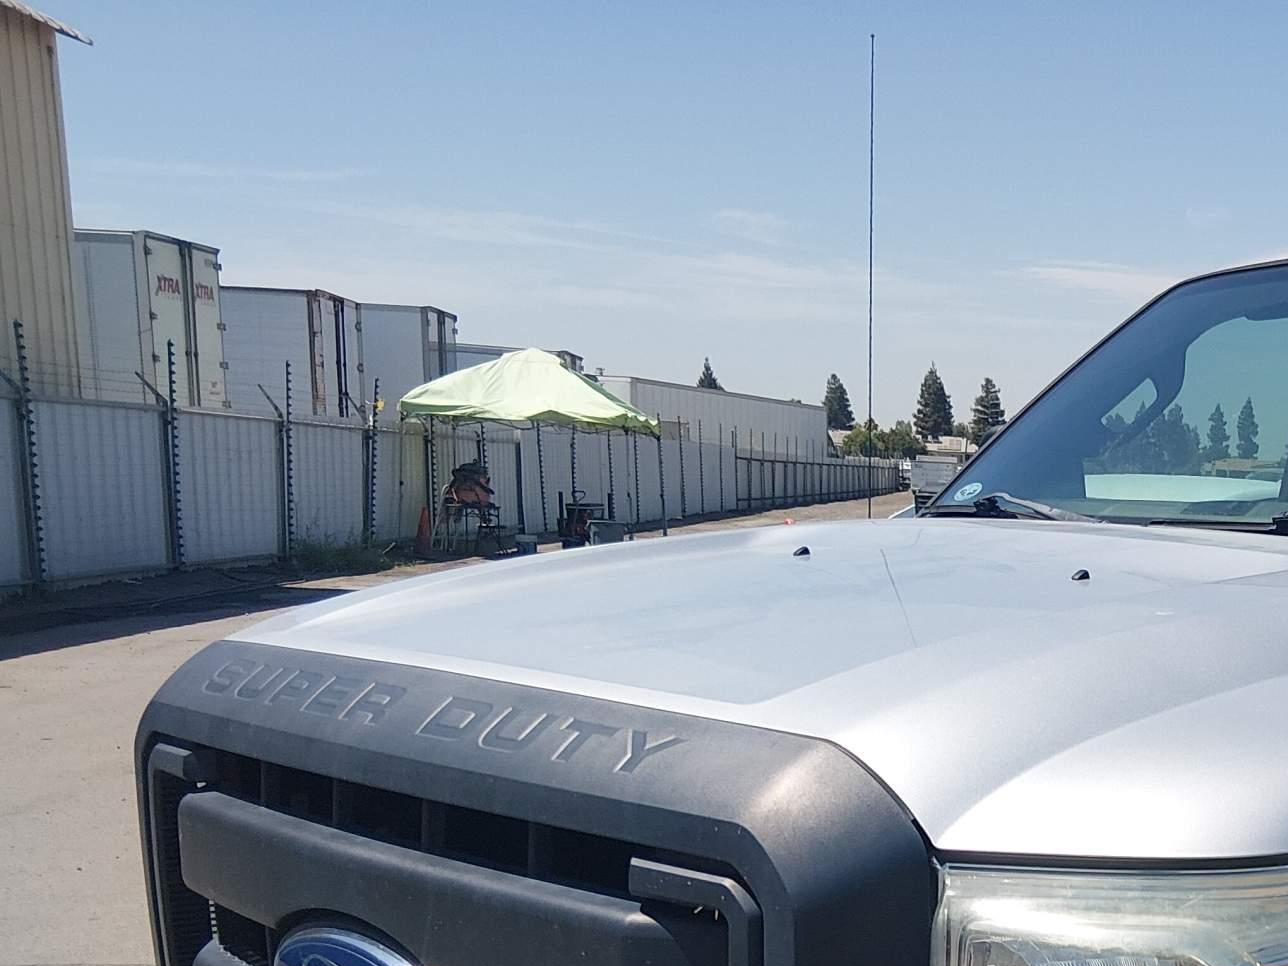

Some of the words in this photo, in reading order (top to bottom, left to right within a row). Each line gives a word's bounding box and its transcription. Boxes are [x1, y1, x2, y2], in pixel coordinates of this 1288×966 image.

[156, 274, 181, 296] XTRA
[194, 282, 215, 303] XTRA
[202, 658, 407, 727] SUPER
[415, 696, 689, 774] DUTY
